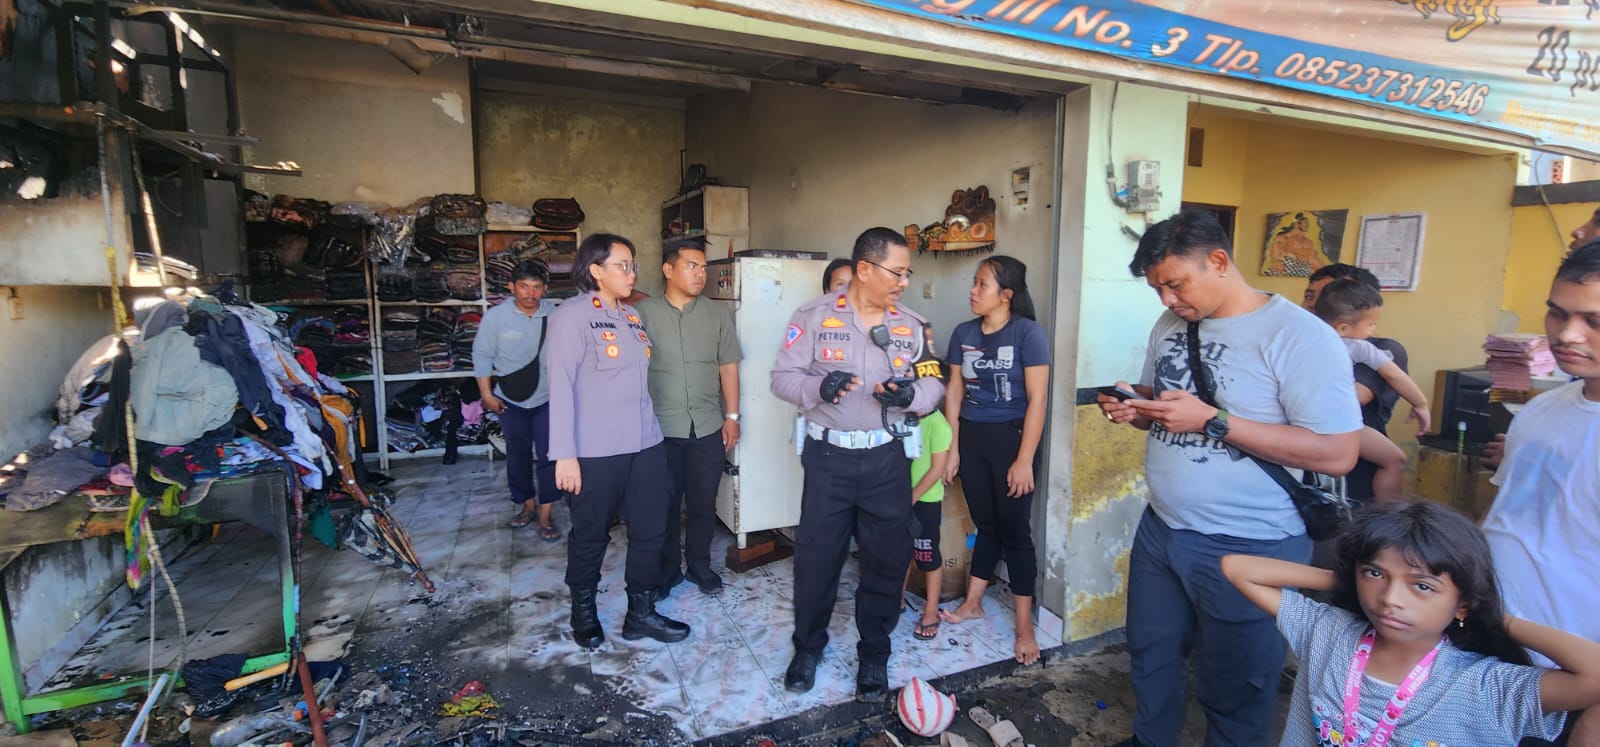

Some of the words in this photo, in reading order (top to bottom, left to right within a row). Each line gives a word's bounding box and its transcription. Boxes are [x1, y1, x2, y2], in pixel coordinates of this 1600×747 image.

[1051, 5, 1133, 48] No.
[1151, 27, 1189, 57] 3
[1192, 33, 1260, 73] Tlp.
[1274, 52, 1490, 116] 085237312546
[1526, 26, 1571, 82] 20
[818, 331, 851, 342] PETRUS
